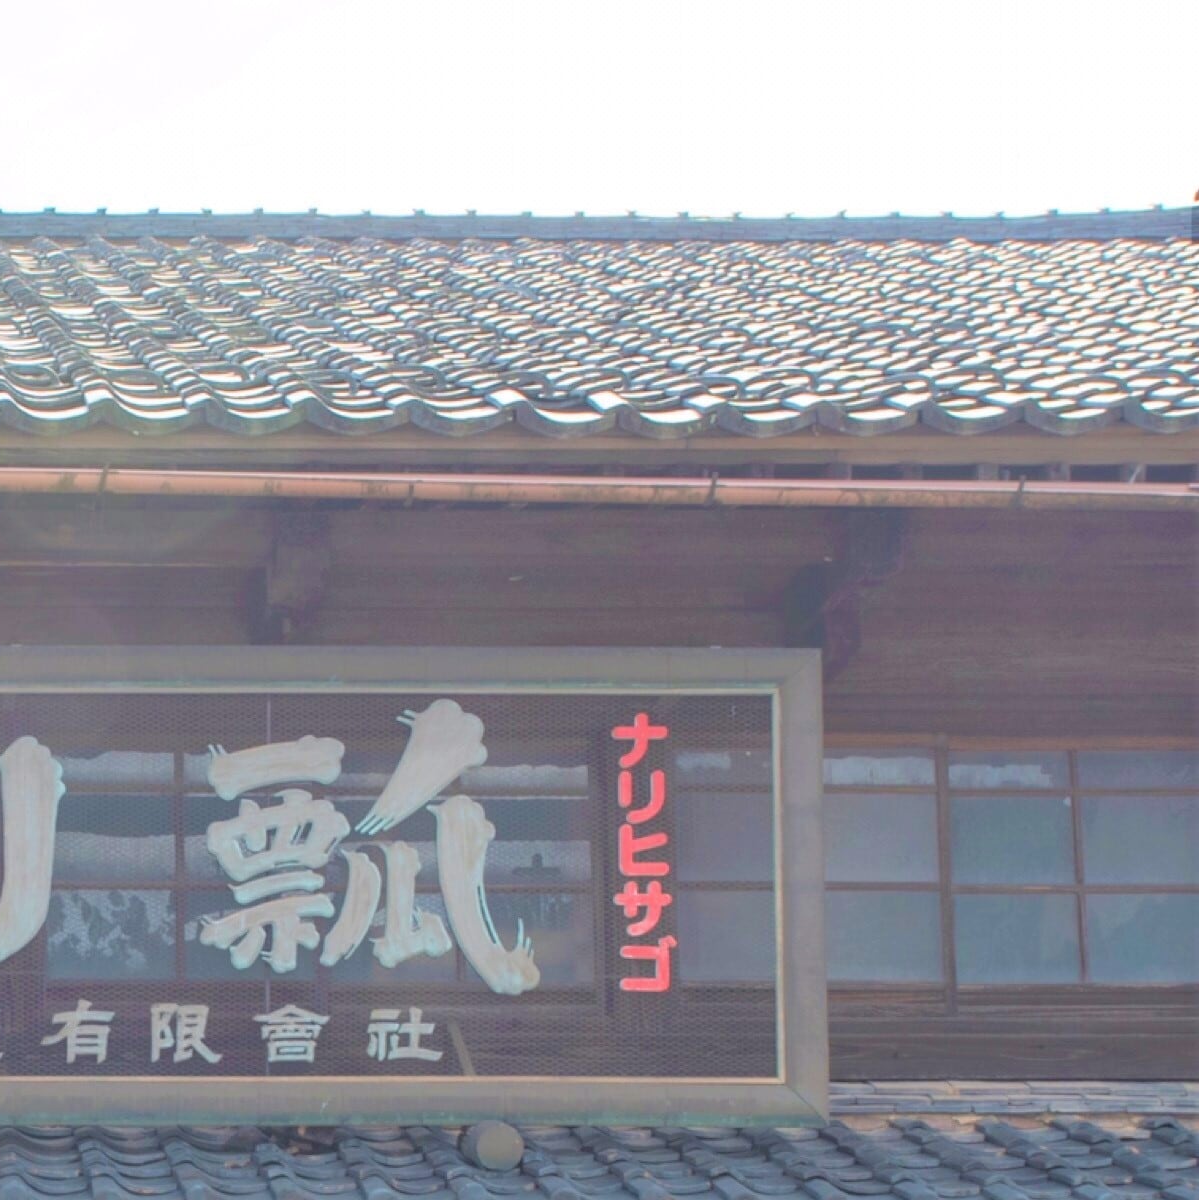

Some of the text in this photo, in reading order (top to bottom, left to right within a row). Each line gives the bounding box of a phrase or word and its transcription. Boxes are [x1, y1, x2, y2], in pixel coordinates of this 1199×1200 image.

[611, 712, 677, 992] ナリヒサゴ
